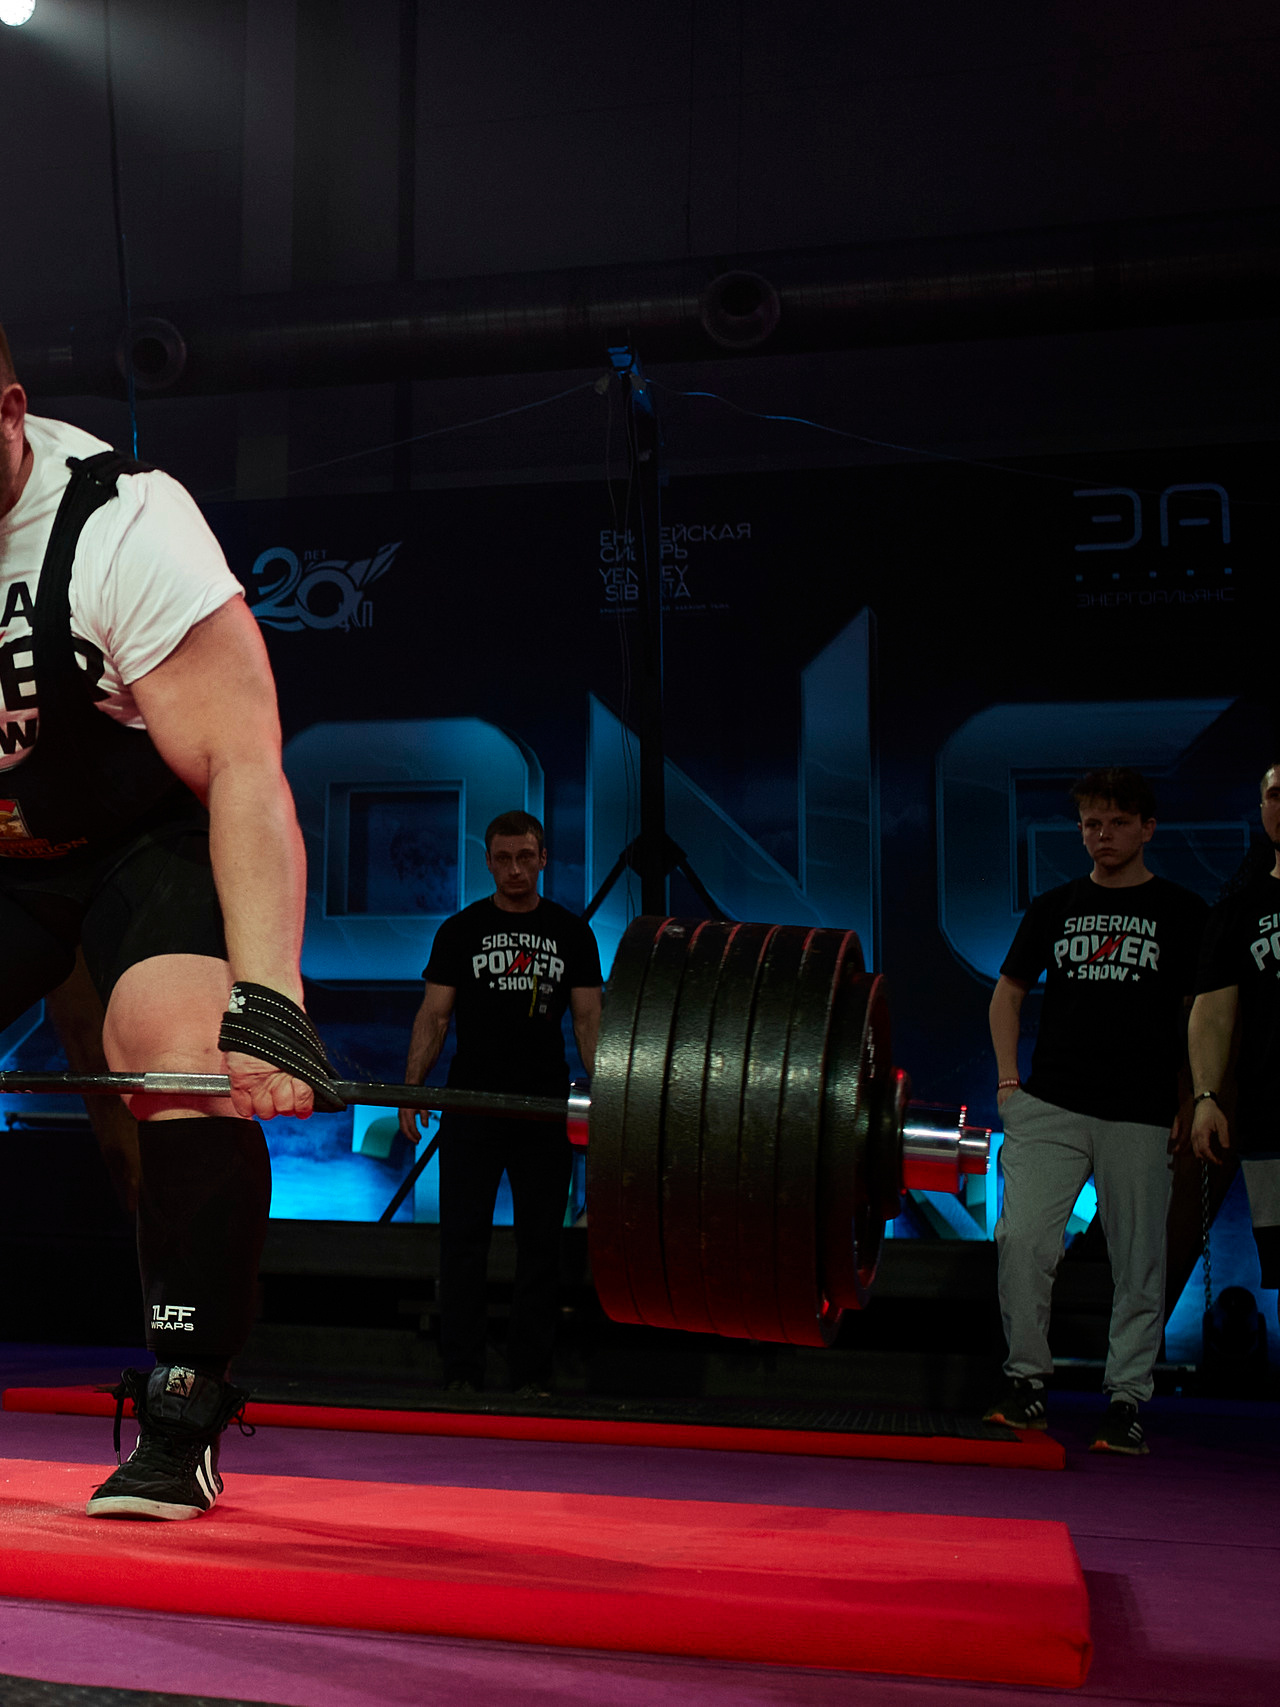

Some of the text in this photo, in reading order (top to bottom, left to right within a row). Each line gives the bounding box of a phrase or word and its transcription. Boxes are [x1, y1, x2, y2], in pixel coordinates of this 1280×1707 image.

[599, 522, 752, 547] ЕНЕЙСКАЯ
[599, 543, 688, 563] СИРЬ
[598, 564, 688, 585] YENEY
[1063, 914, 1157, 937] SIBERIAN
[482, 932, 557, 955] SIBERIAN
[1053, 933, 1160, 972] POWER
[472, 949, 565, 983] POWER
[1077, 963, 1129, 982] SHOW
[151, 1321, 195, 1331] WRAPS
